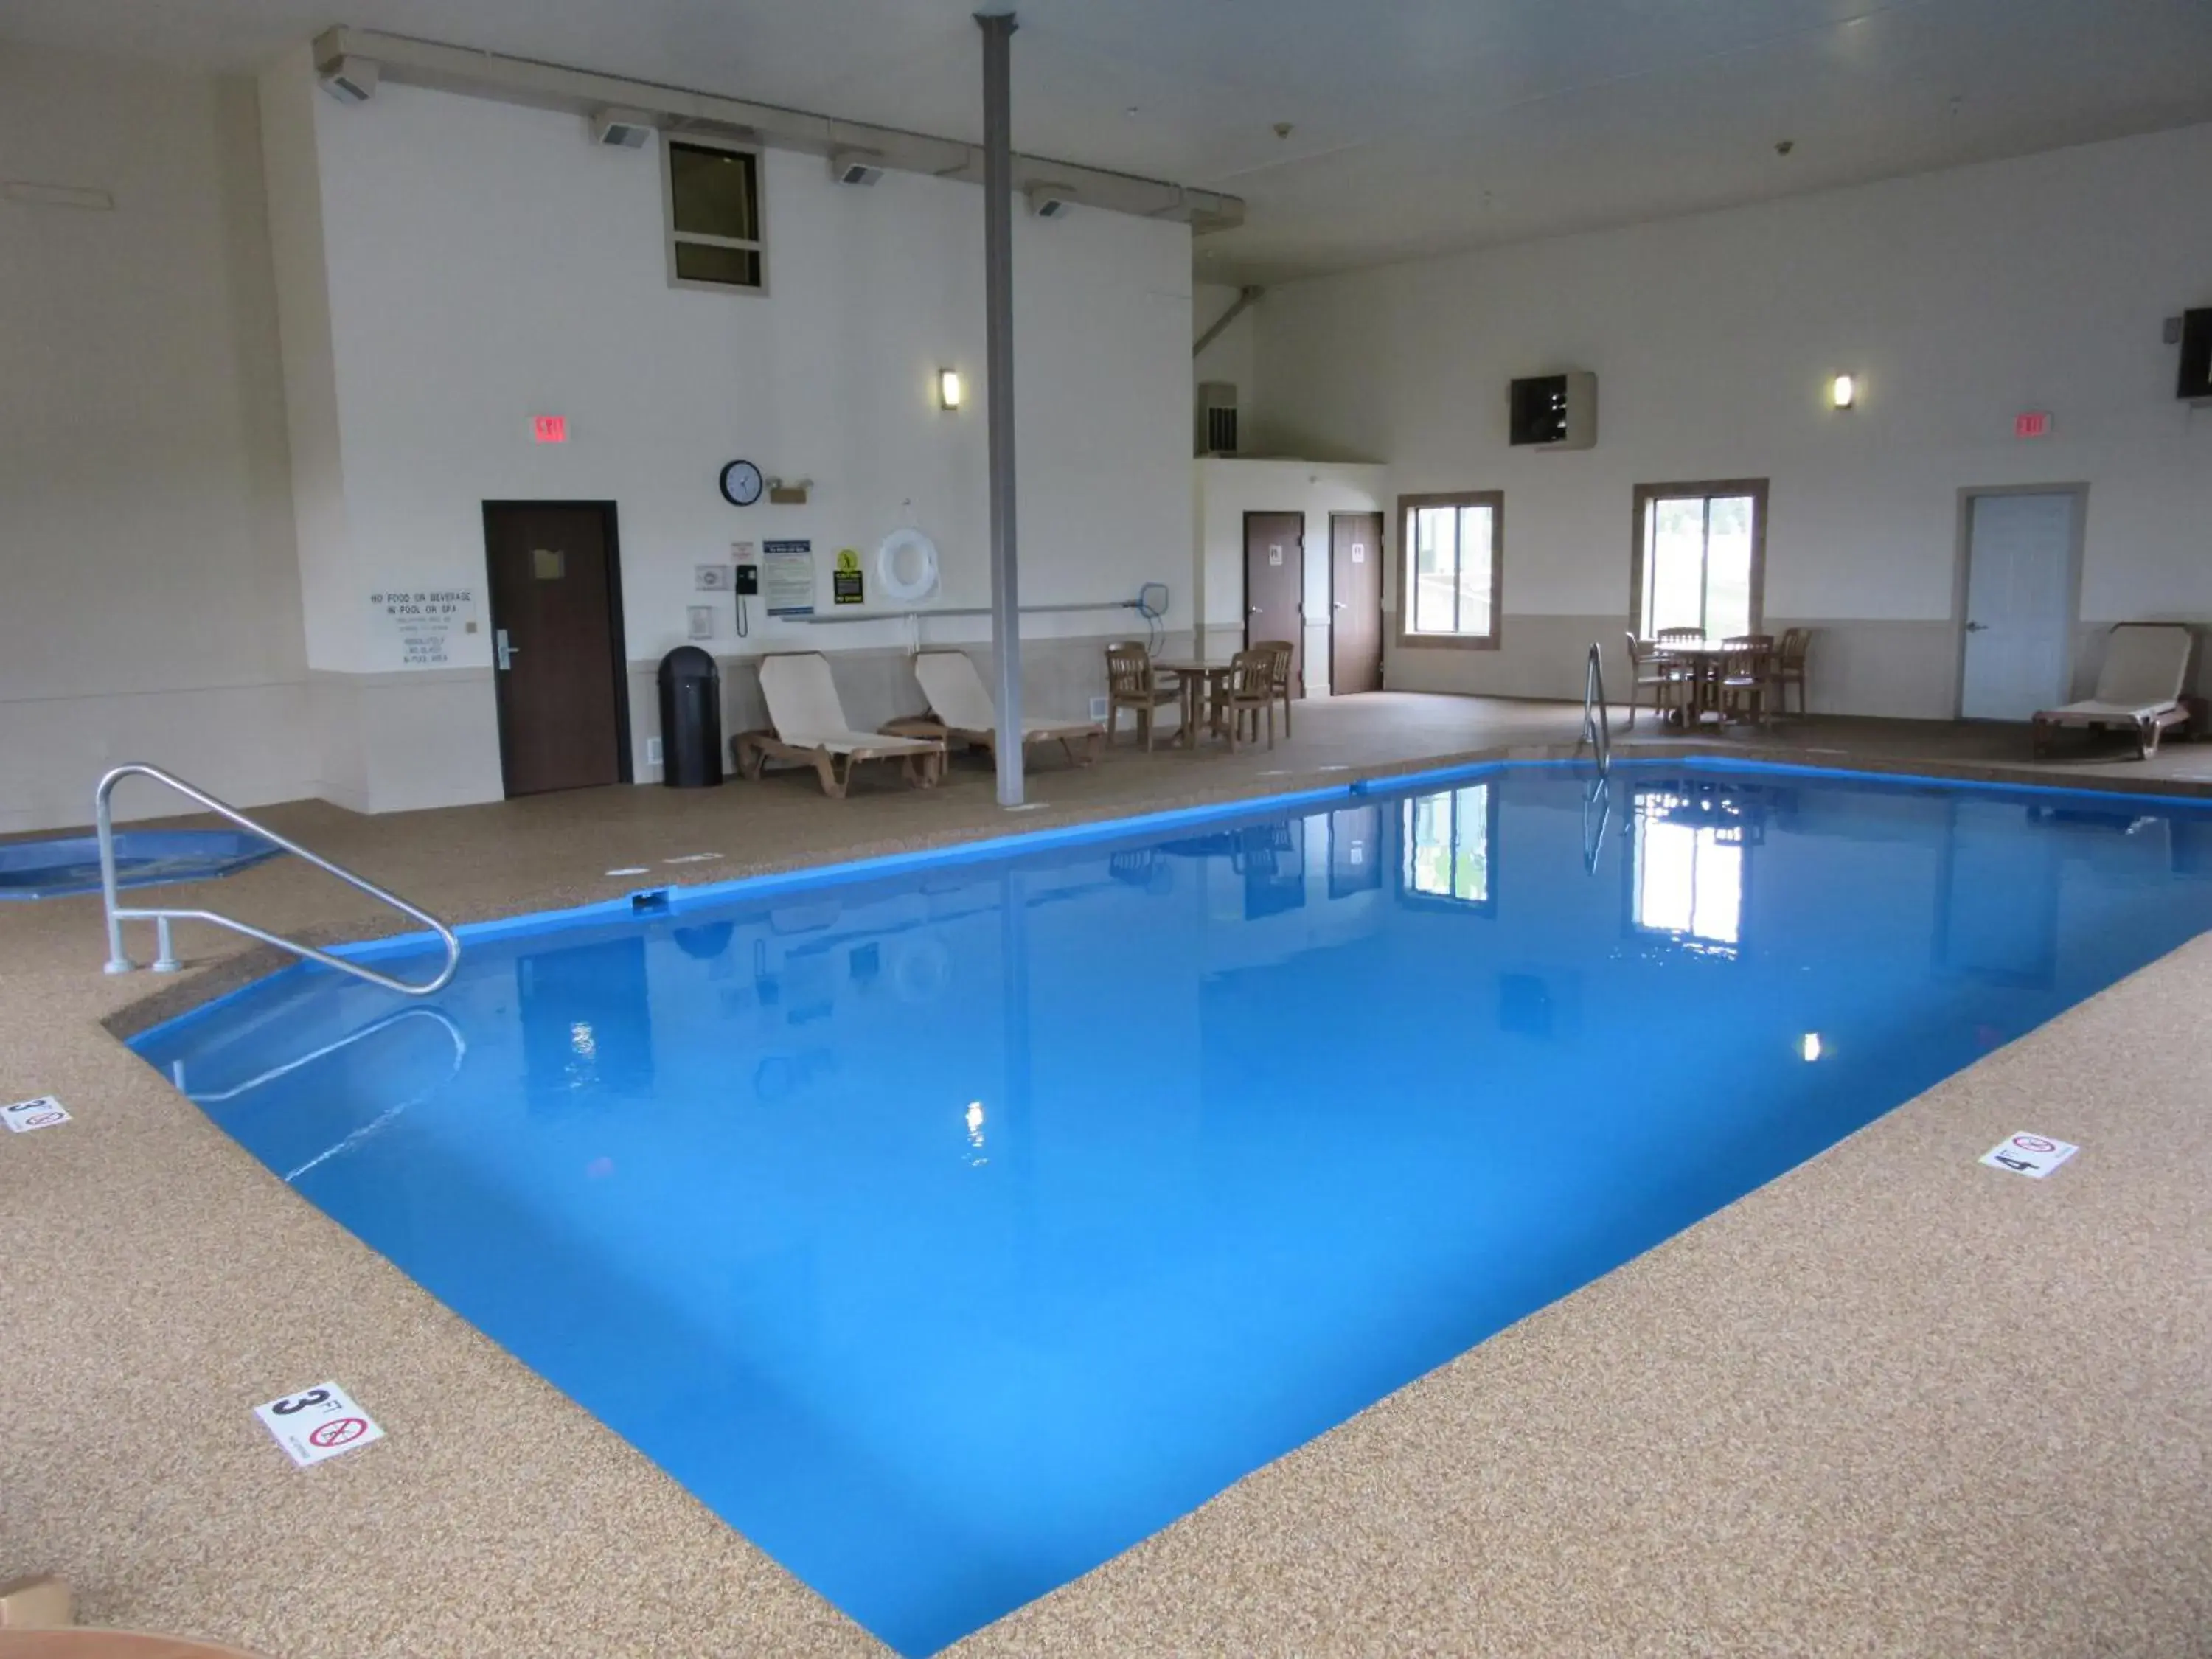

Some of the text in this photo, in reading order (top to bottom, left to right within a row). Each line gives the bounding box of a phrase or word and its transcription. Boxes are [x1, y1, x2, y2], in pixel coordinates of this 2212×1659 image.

[535, 417, 565, 441] EXIT
[371, 591, 471, 603] NO FOOD OR BEVERAGE
[400, 605, 421, 614] POOL
[425, 605, 437, 614] OR
[442, 605, 457, 613] SPA
[7, 1099, 46, 1112] 3
[1994, 1155, 2040, 1172] 4
[271, 1389, 330, 1416] 3
